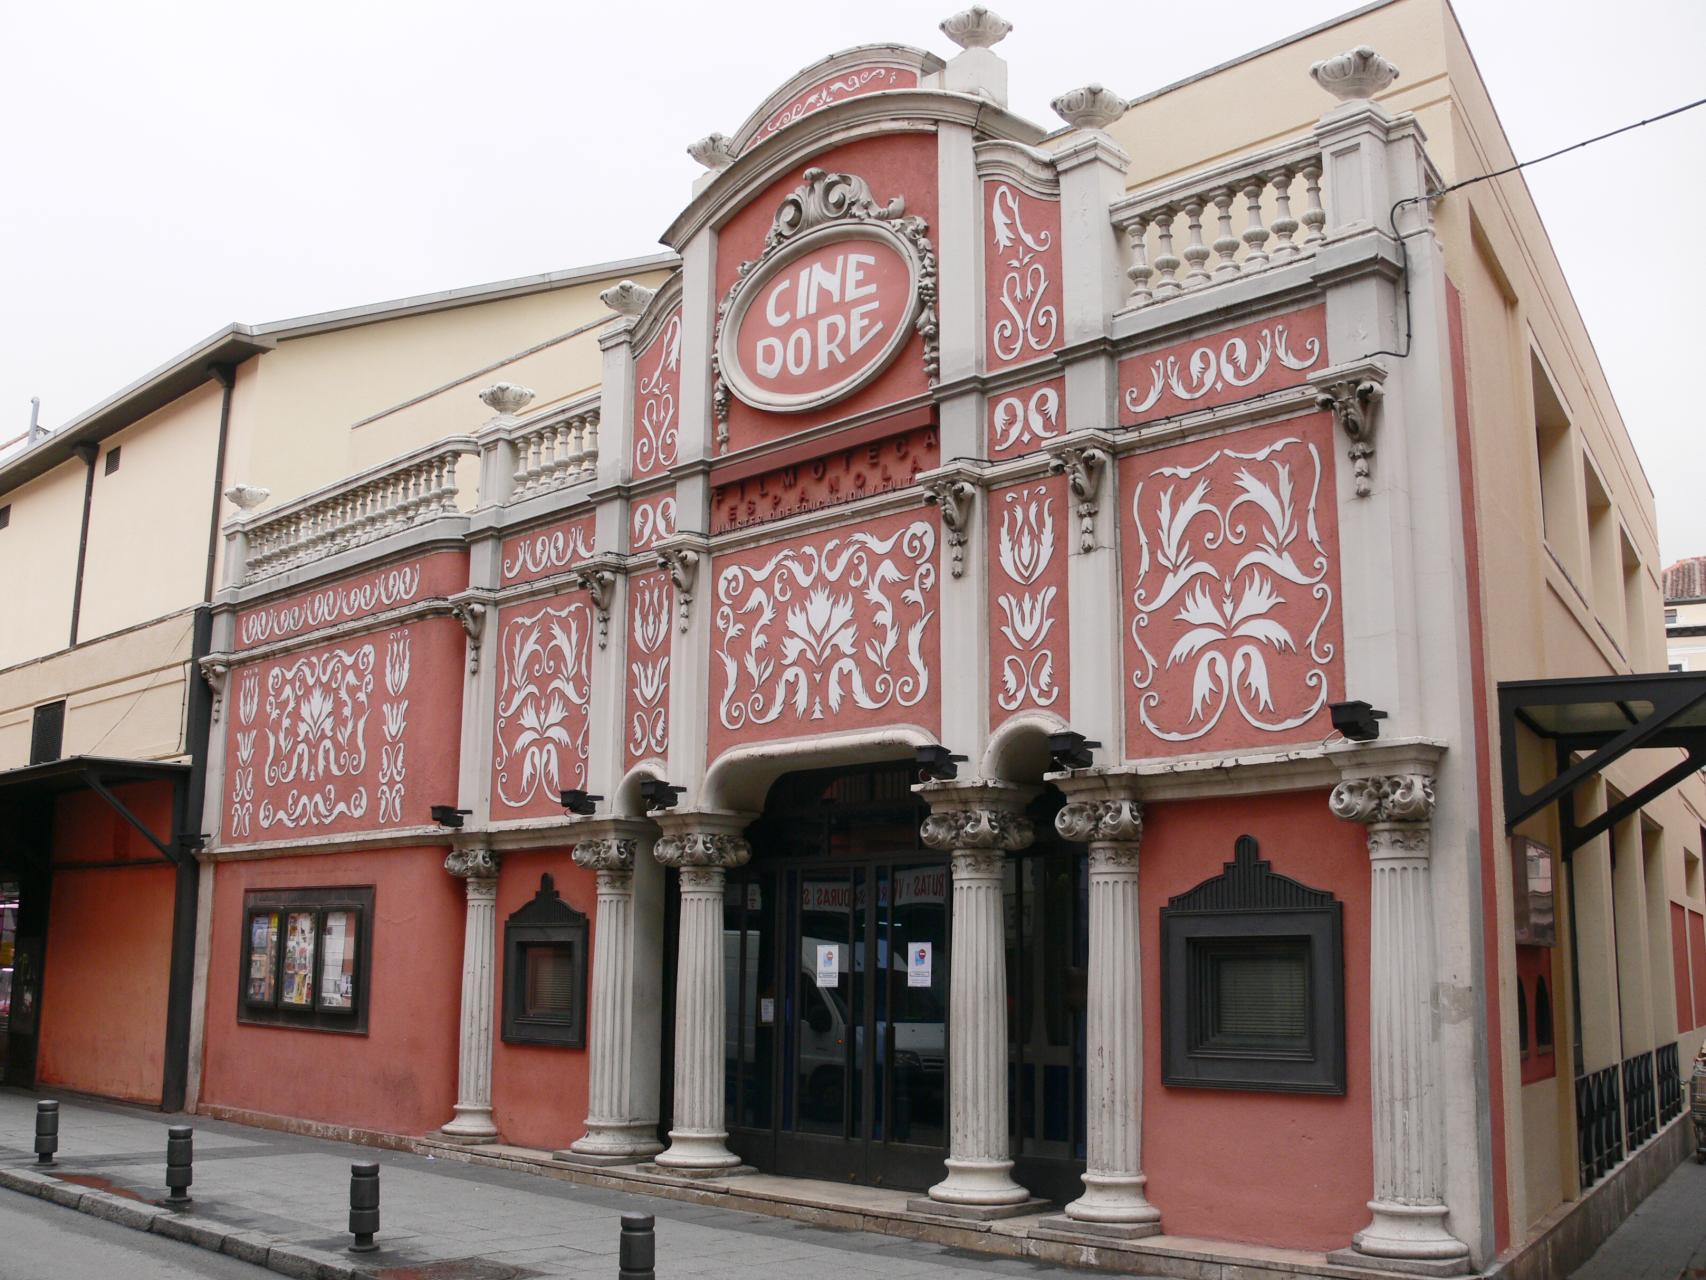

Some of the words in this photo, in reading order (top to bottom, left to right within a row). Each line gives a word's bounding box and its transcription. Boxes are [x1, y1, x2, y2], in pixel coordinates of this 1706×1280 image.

[766, 254, 876, 327] CINE
[756, 301, 884, 379] DORE
[713, 431, 937, 510] FILMOTECA
